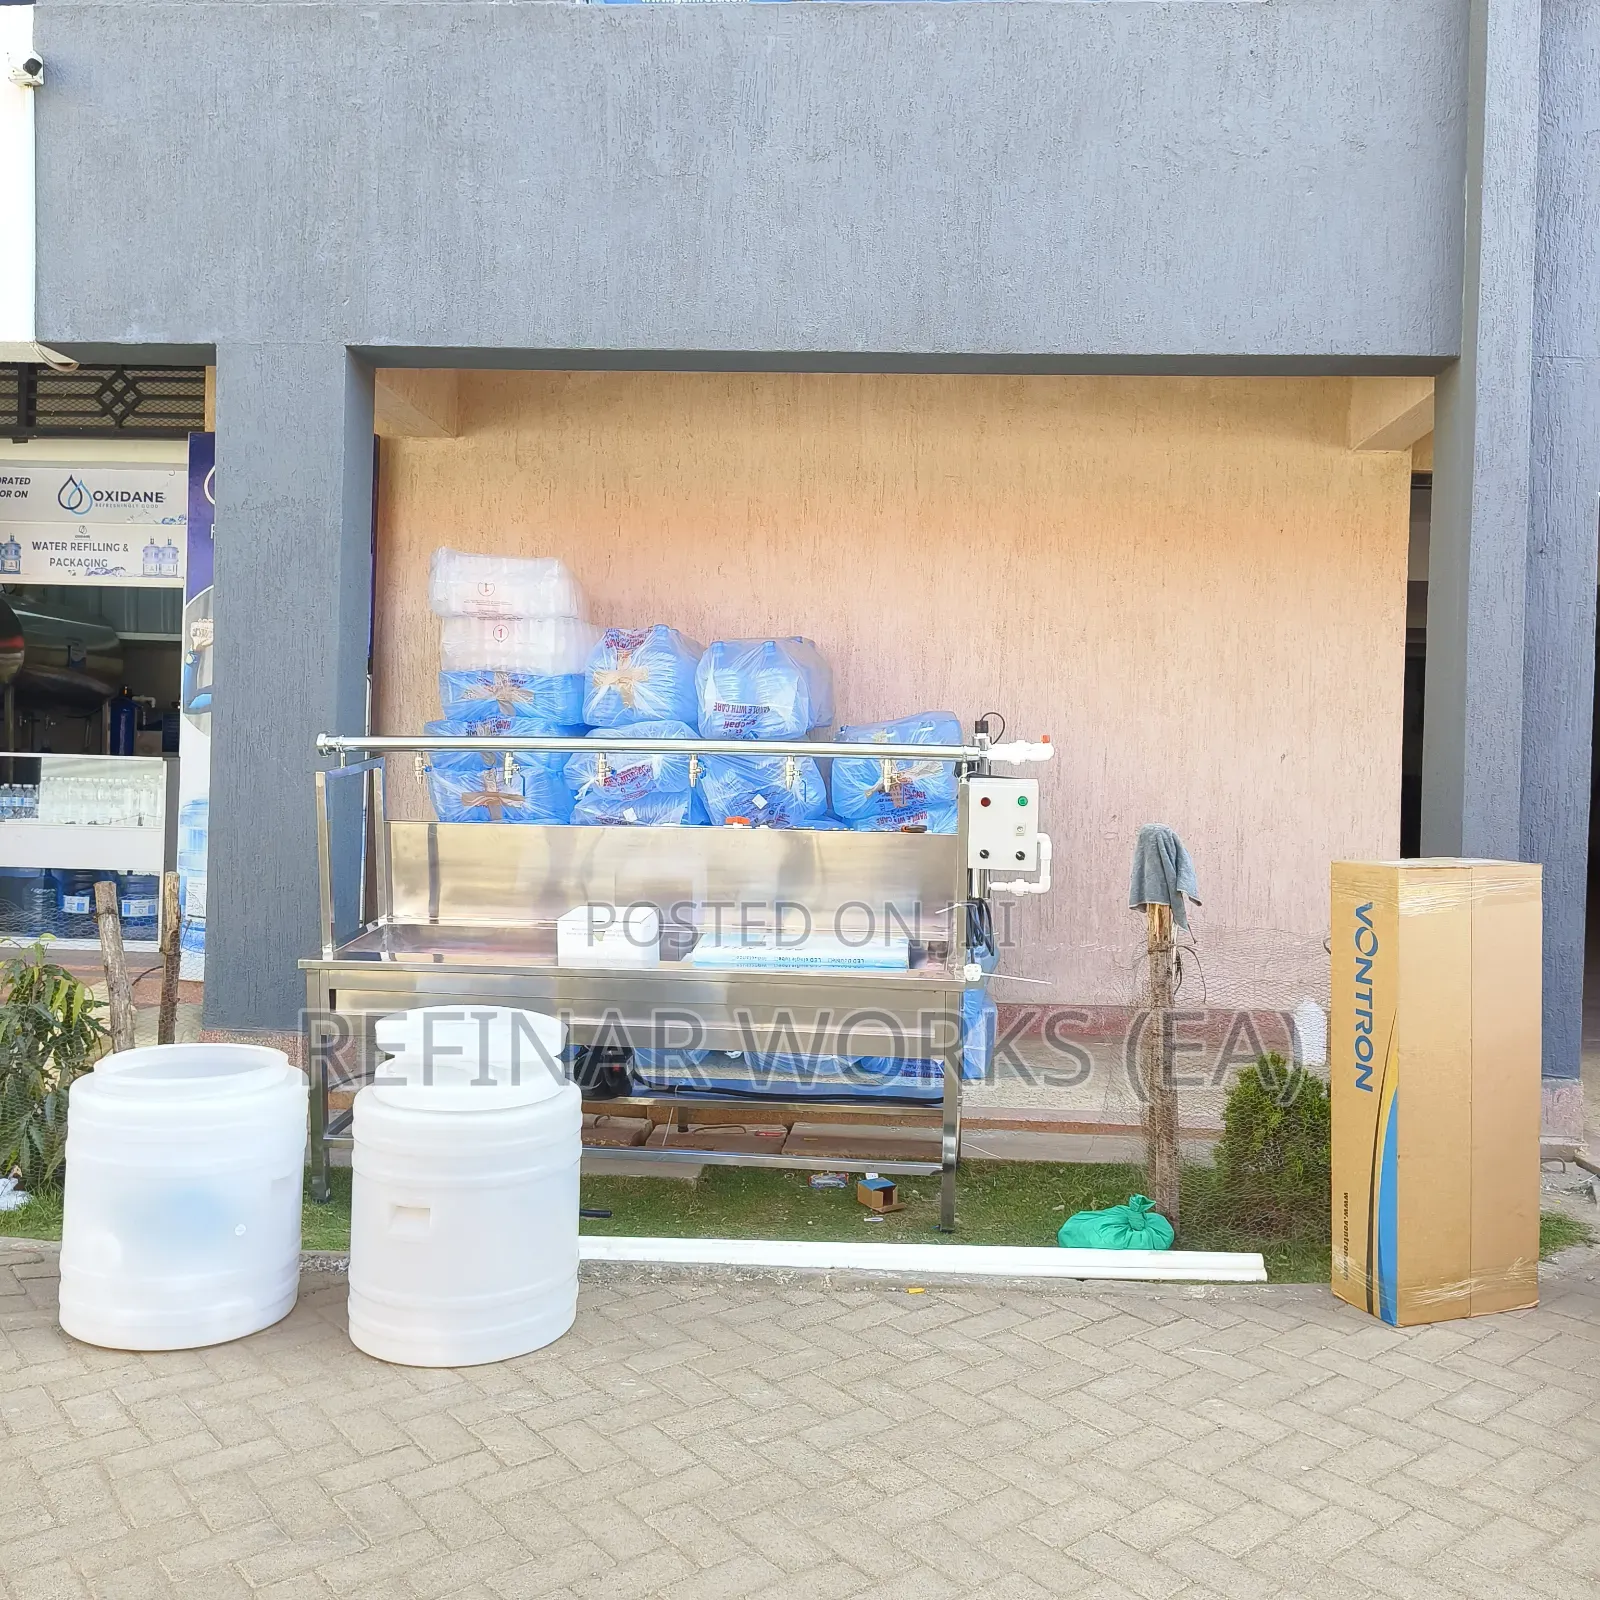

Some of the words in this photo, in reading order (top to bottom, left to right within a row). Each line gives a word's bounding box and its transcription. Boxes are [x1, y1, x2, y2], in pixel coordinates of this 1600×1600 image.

[0, 476, 31, 485] RATED
[14, 490, 28, 498] ON
[93, 490, 164, 503] OXIDANE
[32, 541, 67, 551] WATER
[70, 543, 120, 552] REFILLING
[122, 544, 129, 552] &
[50, 558, 108, 567] PACKAGING
[1354, 902, 1380, 1093] VONTRON
